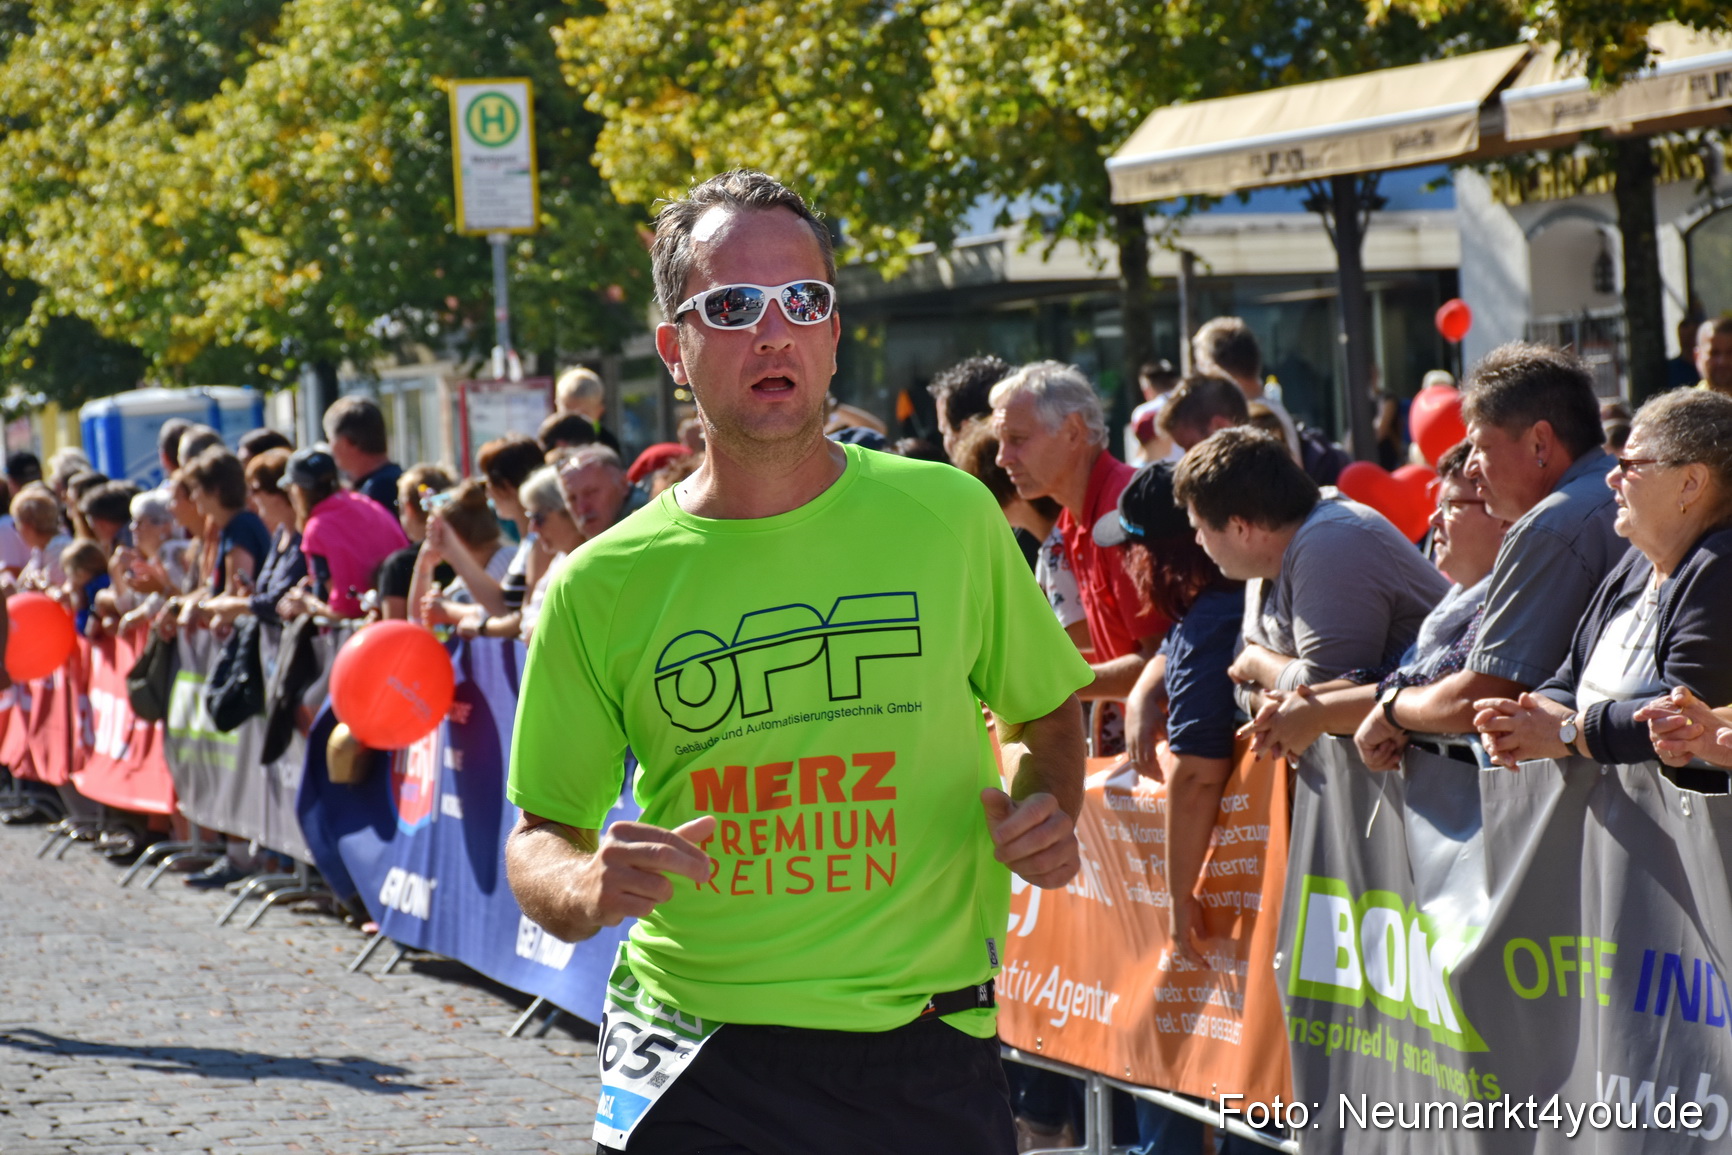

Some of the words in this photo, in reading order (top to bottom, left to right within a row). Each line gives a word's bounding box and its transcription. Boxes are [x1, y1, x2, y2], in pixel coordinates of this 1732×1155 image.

[721, 725, 744, 742] und
[745, 704, 884, 736] Automatisierungstechnik
[886, 700, 923, 715] GmbH
[690, 751, 897, 814] MERZ
[694, 852, 897, 896] REISEN
[996, 960, 1120, 1028] ativAgentur
[1285, 1006, 1382, 1059] inspired
[1385, 1026, 1400, 1073] by
